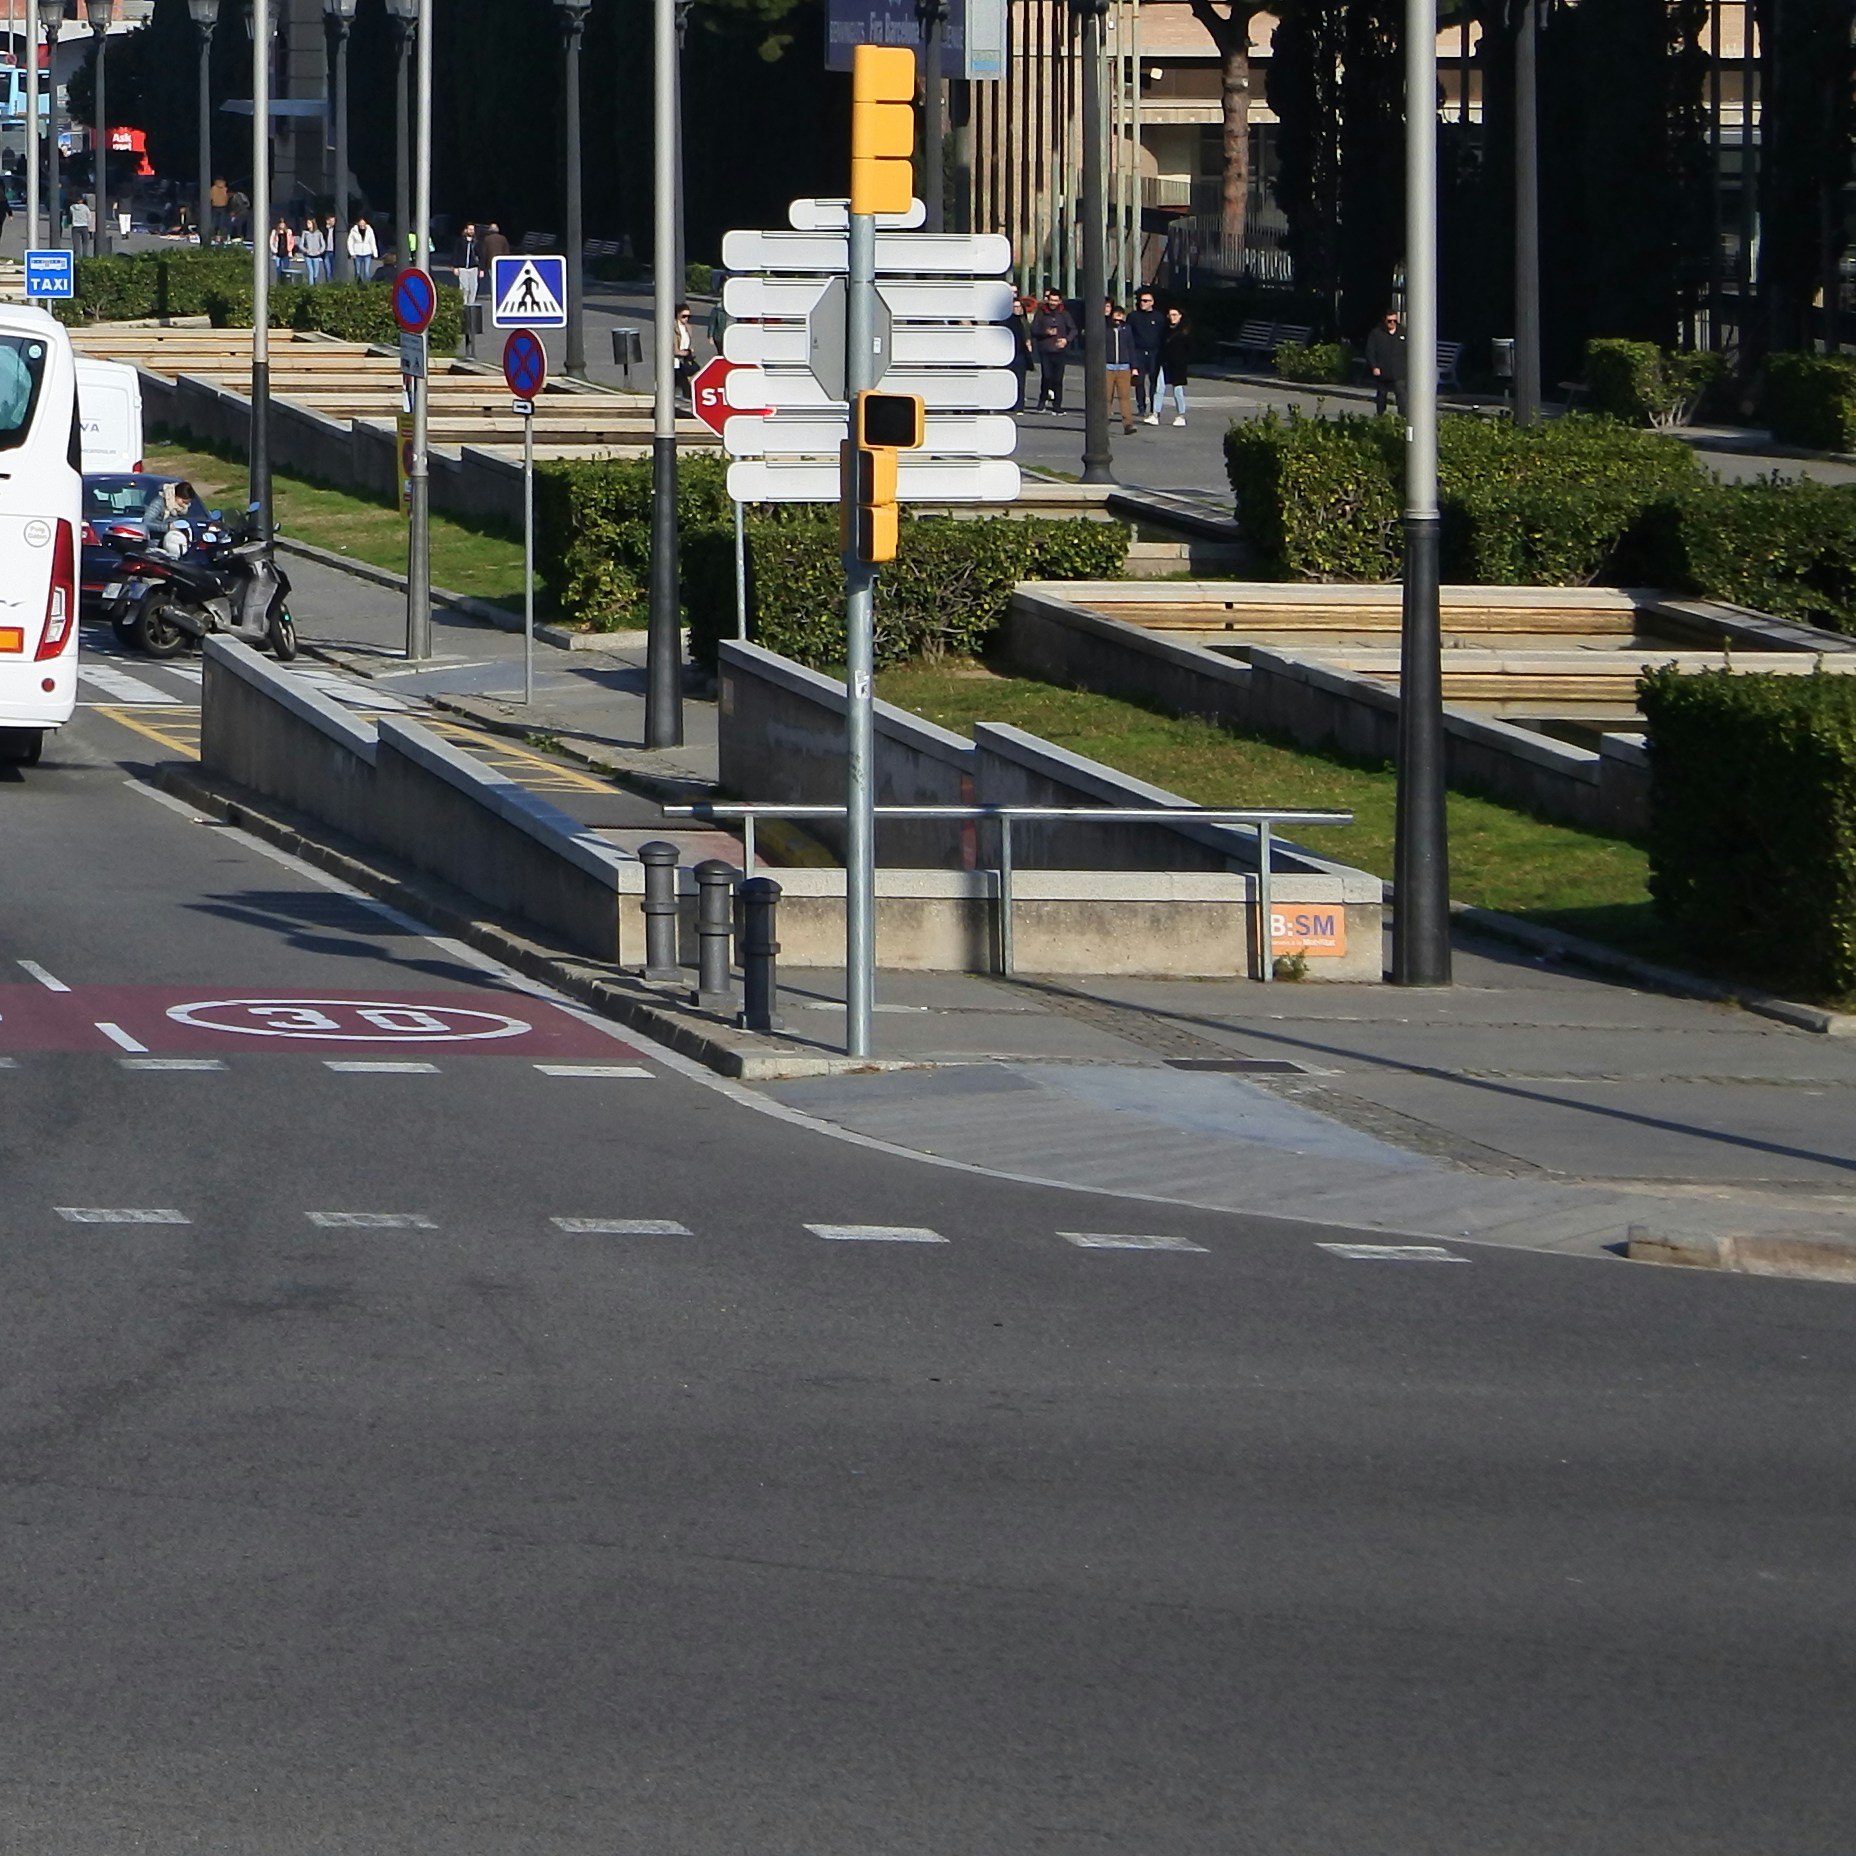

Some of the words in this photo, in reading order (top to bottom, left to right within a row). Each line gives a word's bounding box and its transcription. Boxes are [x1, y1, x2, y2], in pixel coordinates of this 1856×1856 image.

[112, 133, 132, 143] Ask
[31, 278, 68, 291] TAXI
[245, 1006, 452, 1033] 30
